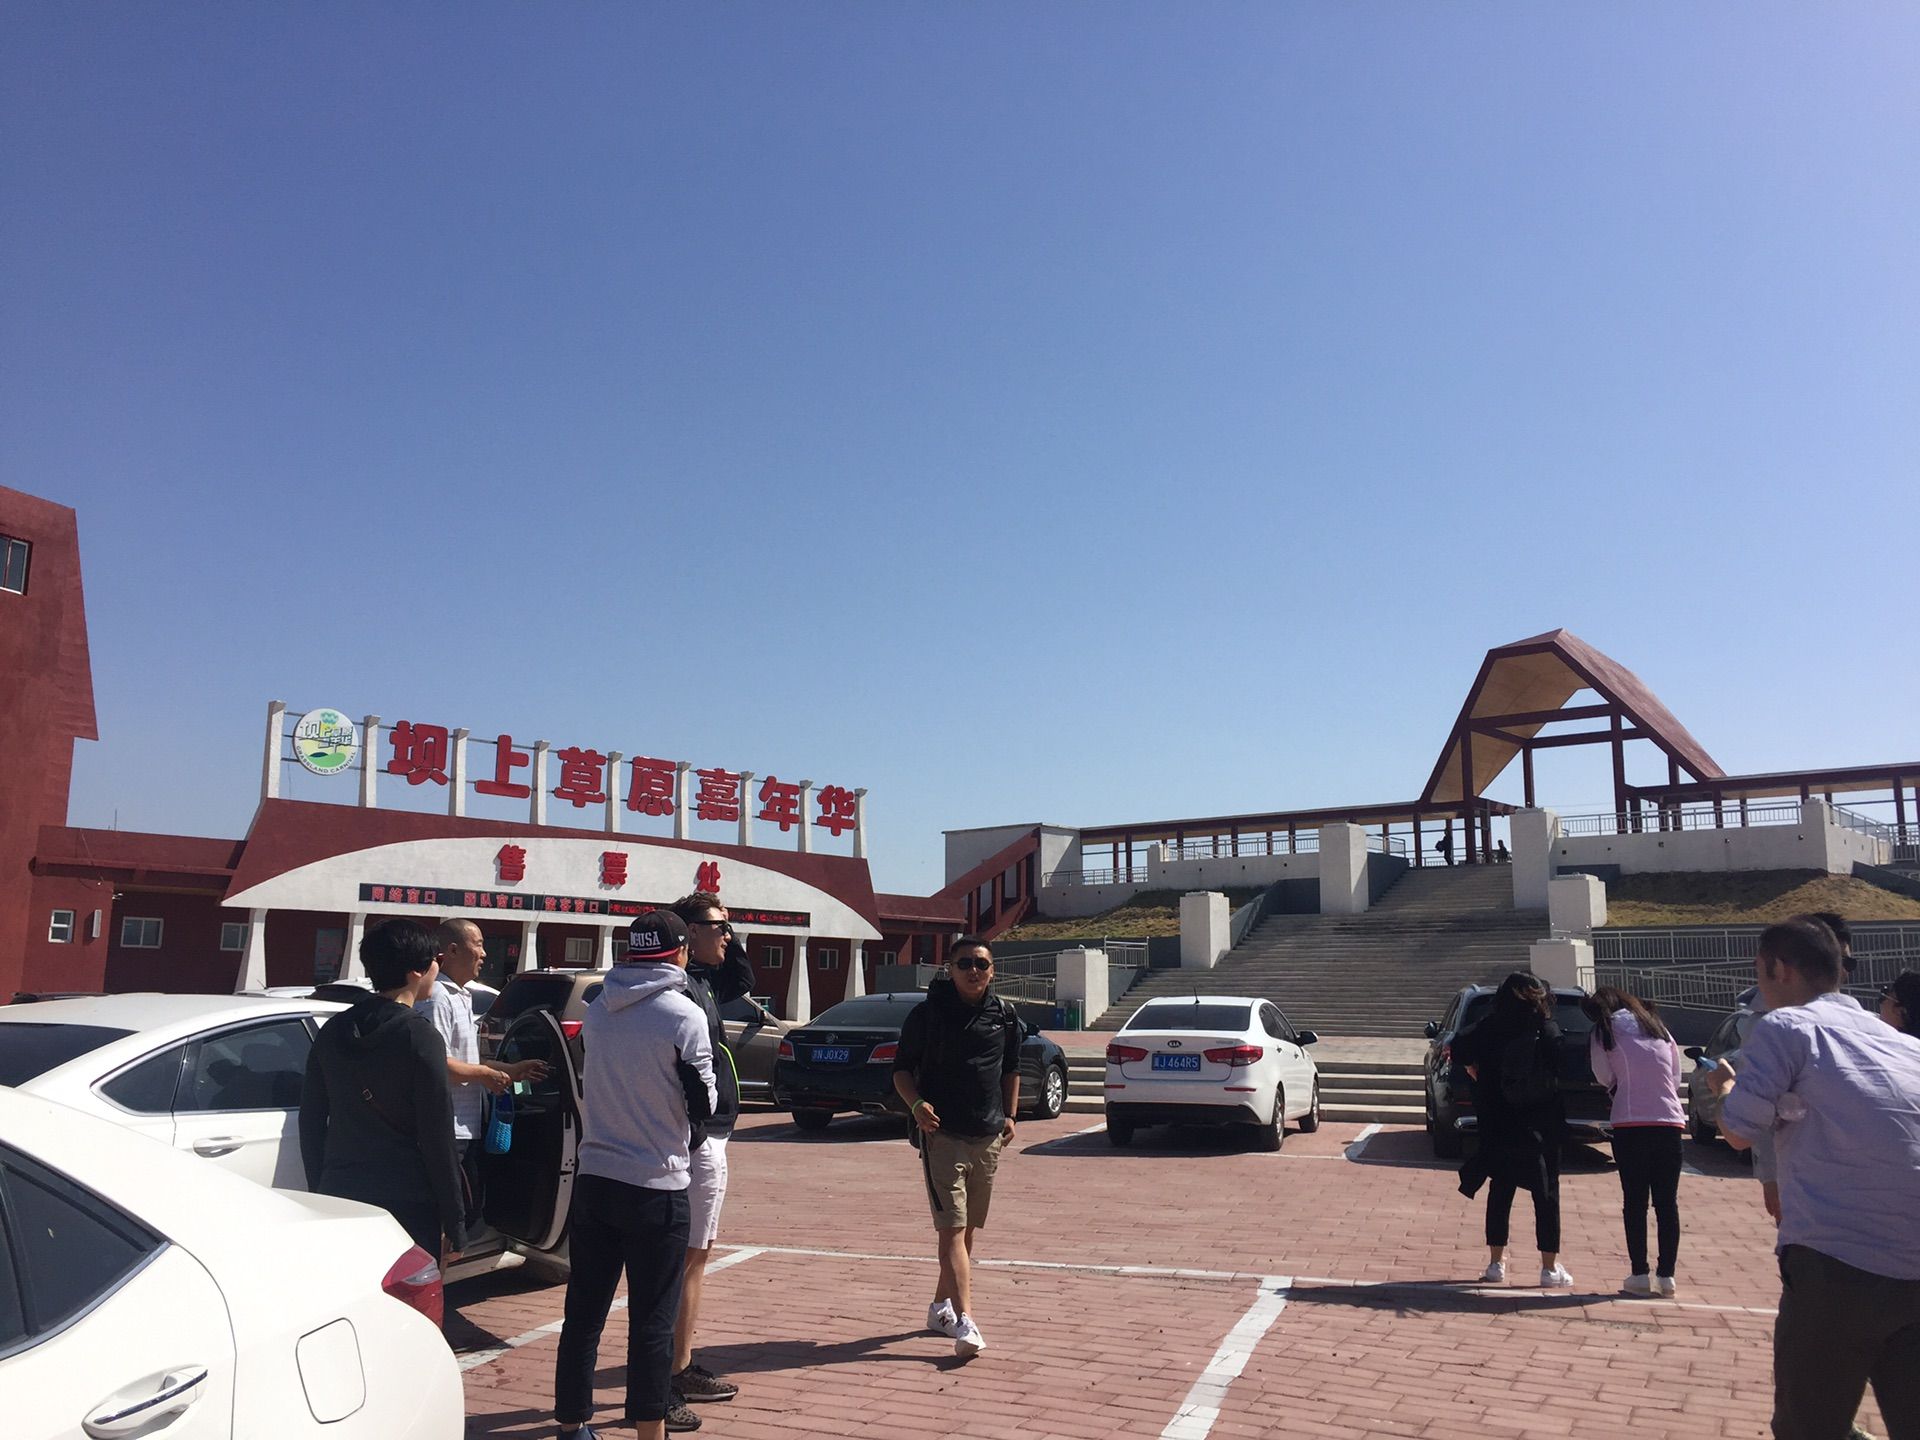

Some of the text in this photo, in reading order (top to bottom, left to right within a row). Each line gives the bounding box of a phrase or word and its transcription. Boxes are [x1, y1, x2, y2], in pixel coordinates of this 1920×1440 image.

[387, 720, 856, 837] 坝上草原嘉年华
[497, 844, 721, 893] 售票处
[463, 891, 524, 909] 团队窗口
